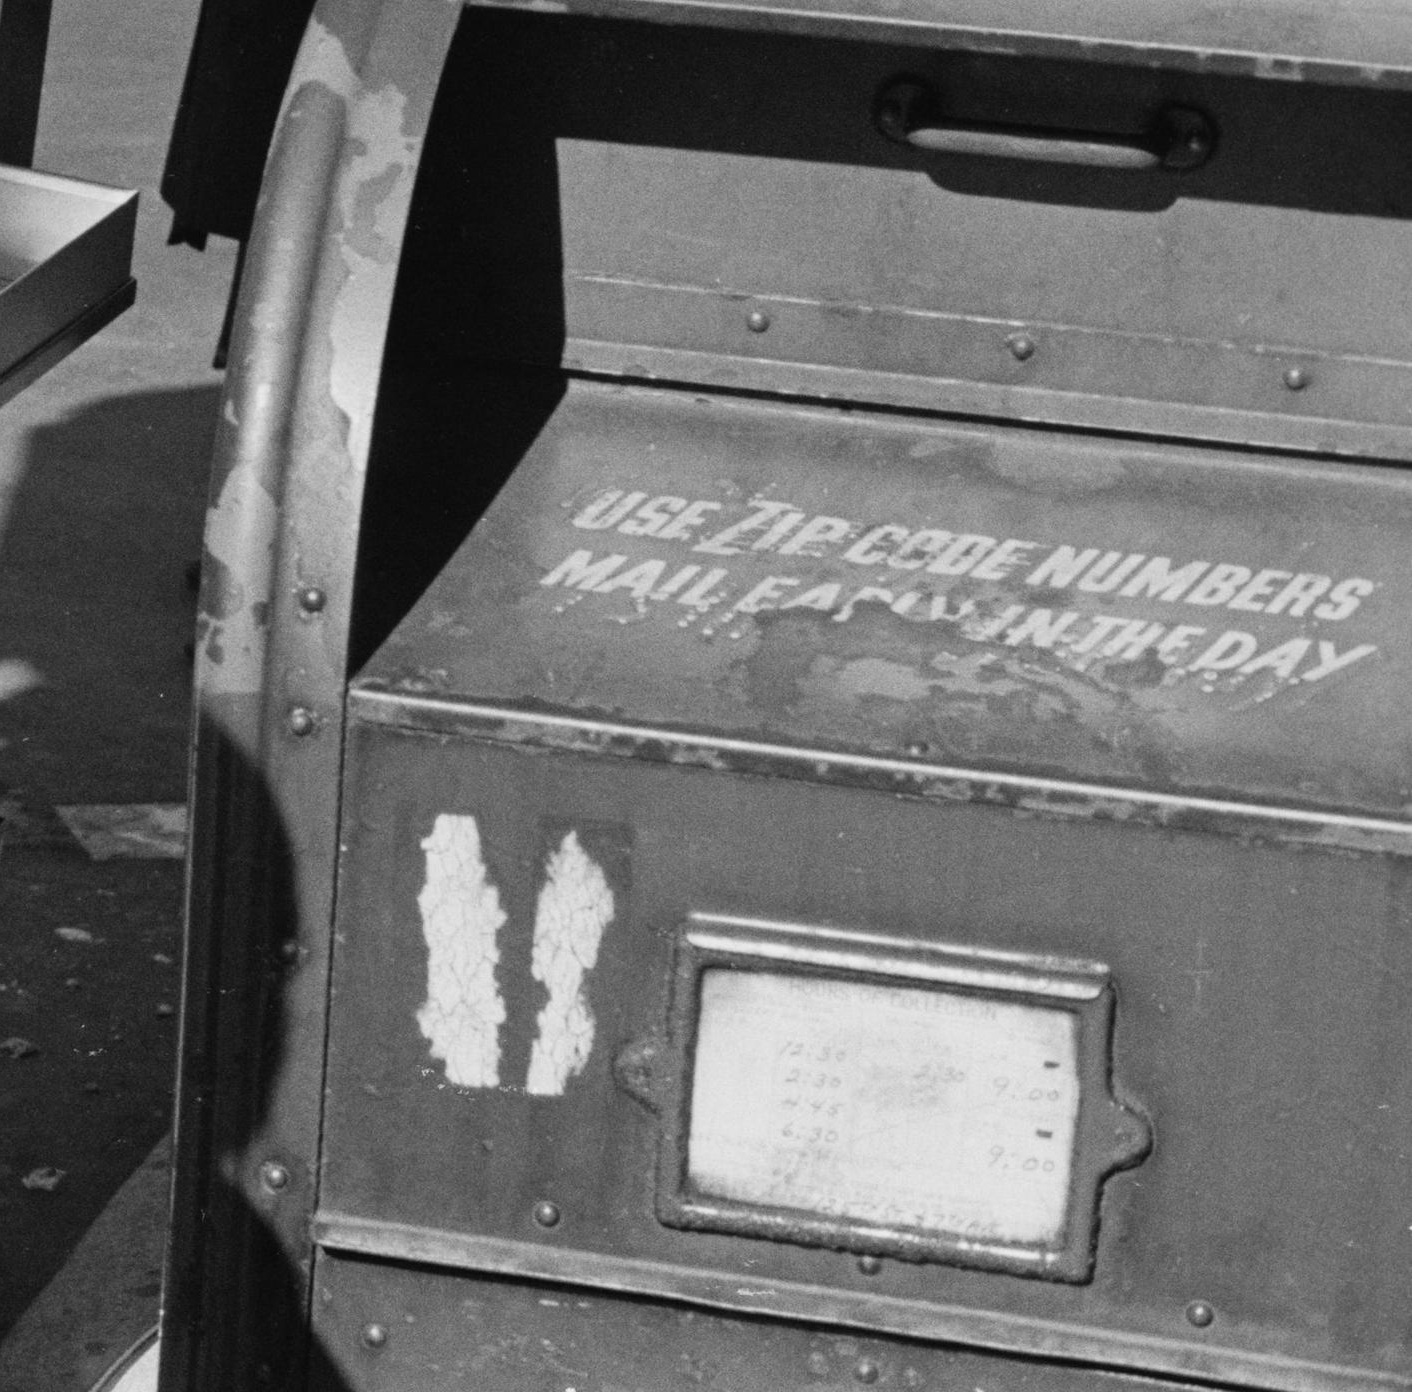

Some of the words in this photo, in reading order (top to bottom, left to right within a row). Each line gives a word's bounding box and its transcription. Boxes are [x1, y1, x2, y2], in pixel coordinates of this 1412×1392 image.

[572, 489, 724, 541] USE
[691, 498, 851, 557] ZIP
[843, 524, 1041, 582] CODE
[1025, 545, 1374, 621] NUMBERS
[539, 549, 729, 606] MAIL
[980, 604, 1080, 647] IN
[1073, 614, 1207, 663] THE
[1189, 630, 1378, 681] DAY
[784, 1067, 843, 1090] 2:30
[780, 1121, 840, 1146] 6:30
[987, 1144, 1057, 1174] 9:00
